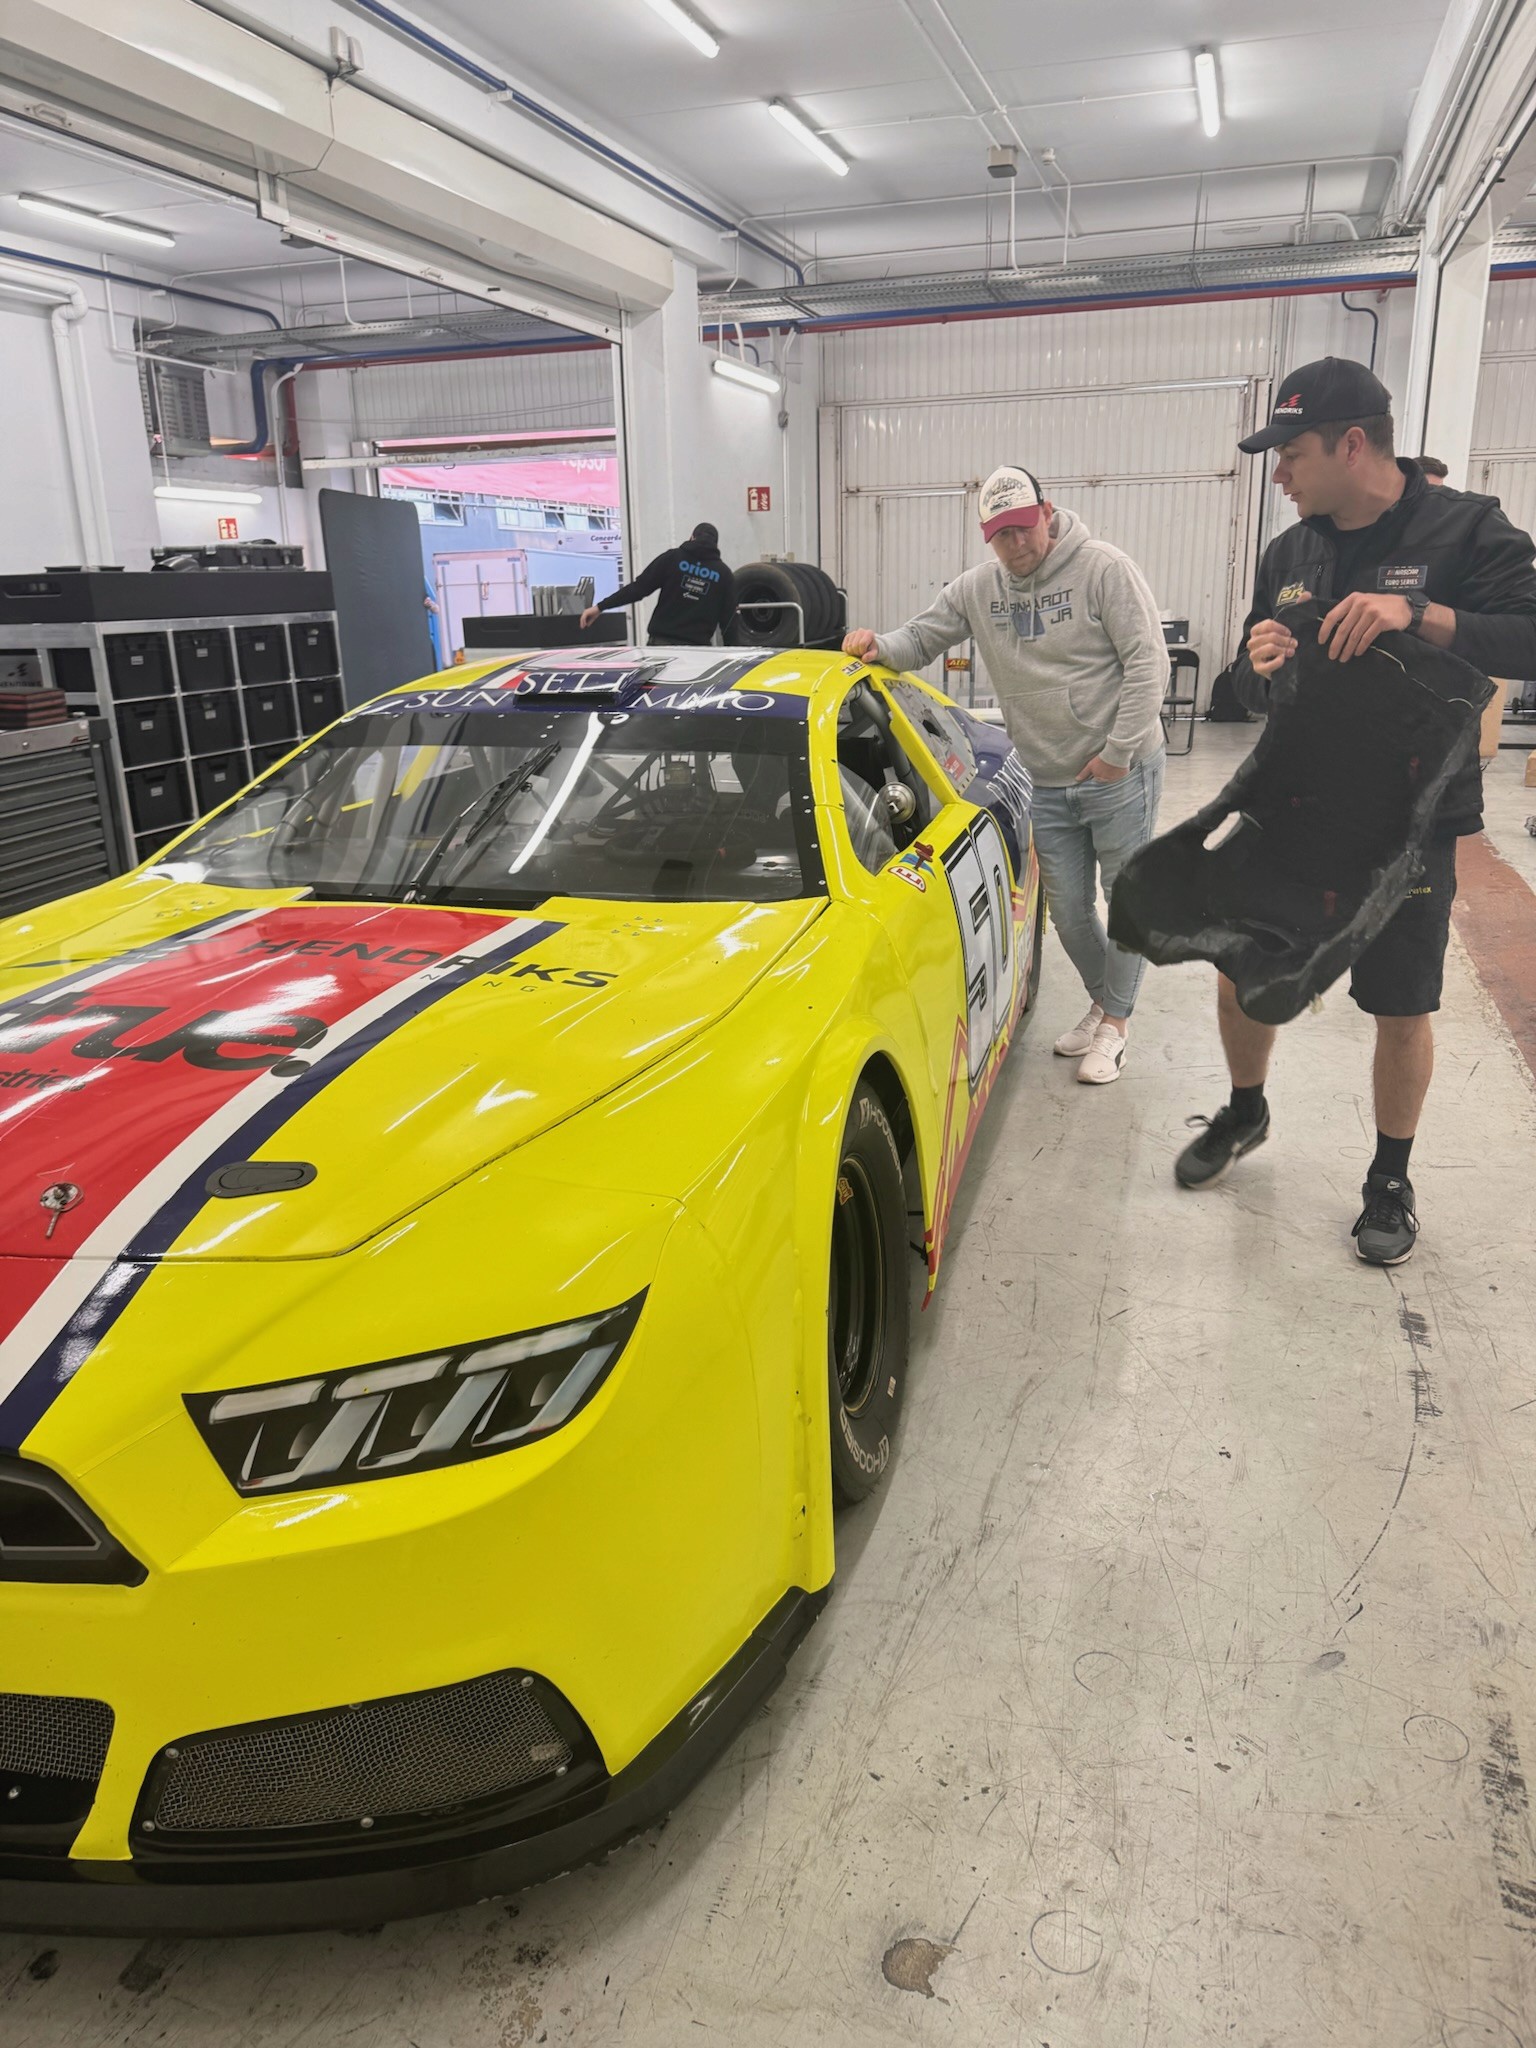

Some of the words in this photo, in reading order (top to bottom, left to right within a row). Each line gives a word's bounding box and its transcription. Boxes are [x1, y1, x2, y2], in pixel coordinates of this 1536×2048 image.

[679, 560, 720, 583] orion
[1050, 606, 1073, 625] JR
[235, 939, 619, 989] HENDRIKS
